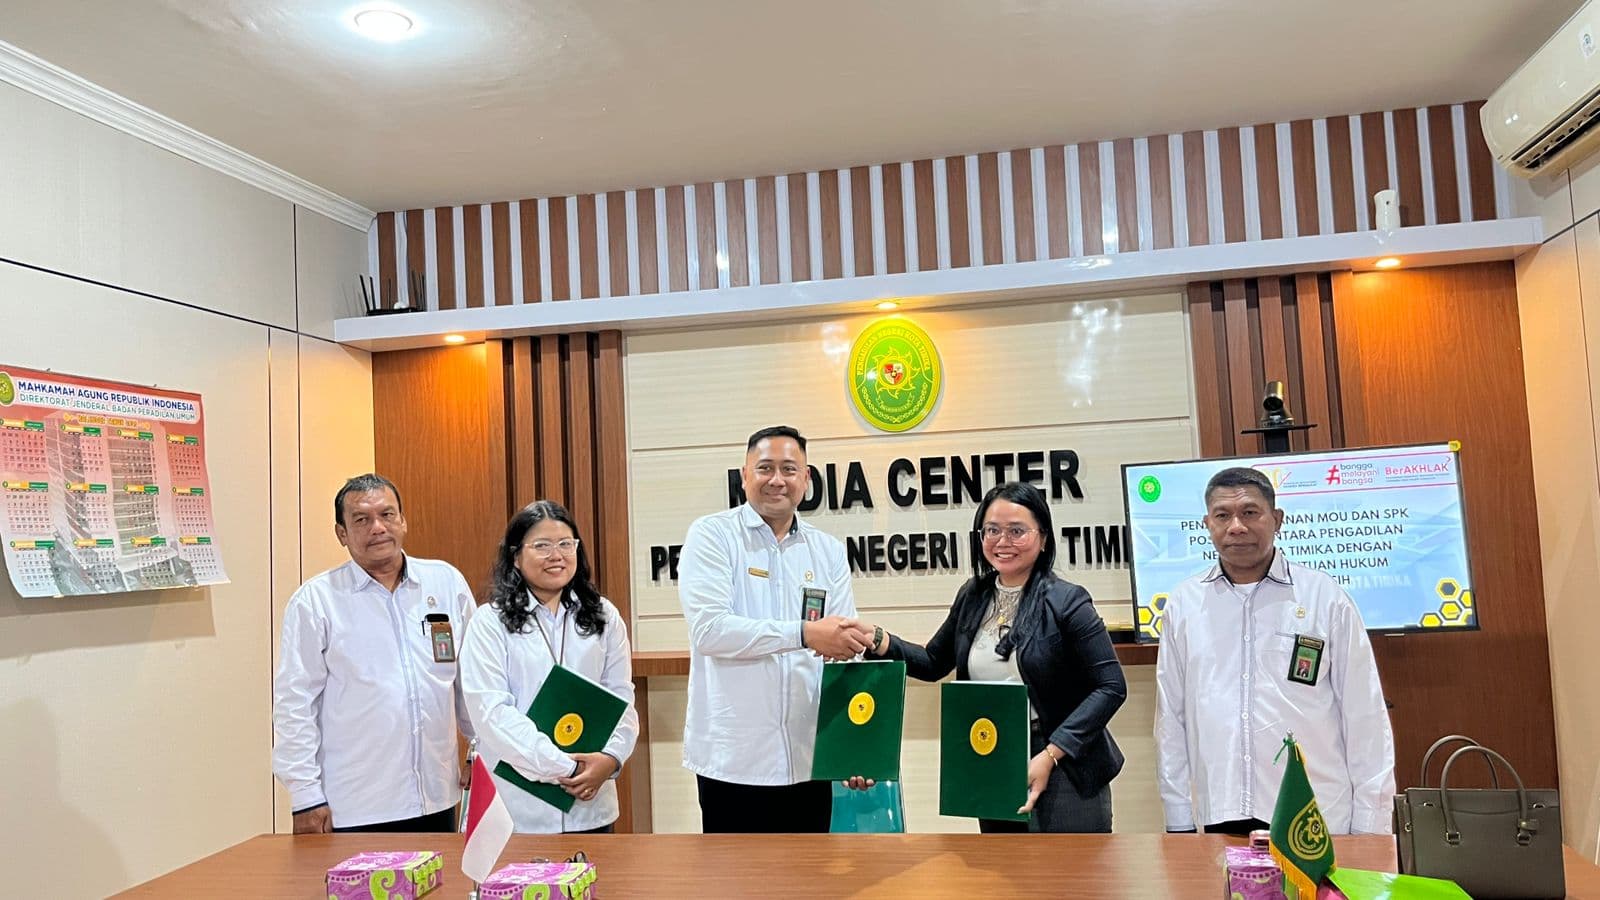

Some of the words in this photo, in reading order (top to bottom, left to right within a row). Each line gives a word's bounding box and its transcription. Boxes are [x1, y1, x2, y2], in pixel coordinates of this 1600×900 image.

[18, 381, 75, 396] MAHKAMAH
[78, 389, 109, 401] AGUNG
[111, 393, 150, 406] REPUBLIK
[152, 399, 194, 411] INDONESIA
[20, 393, 70, 407] DIREKTORAT
[72, 401, 110, 412] JENDERAL
[112, 405, 137, 415] BADAN
[138, 407, 175, 419] PERADILAN
[176, 411, 196, 421] UMUM
[1340, 463, 1373, 471] bangga
[1385, 463, 1449, 475] BerAKHLAK
[728, 462, 874, 511] DIA
[888, 449, 1084, 507] CENTER
[1342, 476, 1373, 486] bangsa
[1317, 511, 1348, 523] MOU
[1351, 509, 1380, 521] DAN
[1384, 507, 1409, 519] SPK
[1275, 529, 1317, 541] NTARA
[1319, 524, 1403, 538] PENGADILAN
[846, 531, 958, 572] NEGERI
[1061, 525, 1130, 565] TIMI
[1288, 543, 1334, 556] TIMIKA
[1337, 541, 1392, 553] DENGAN
[1340, 557, 1389, 569] HUKUM
